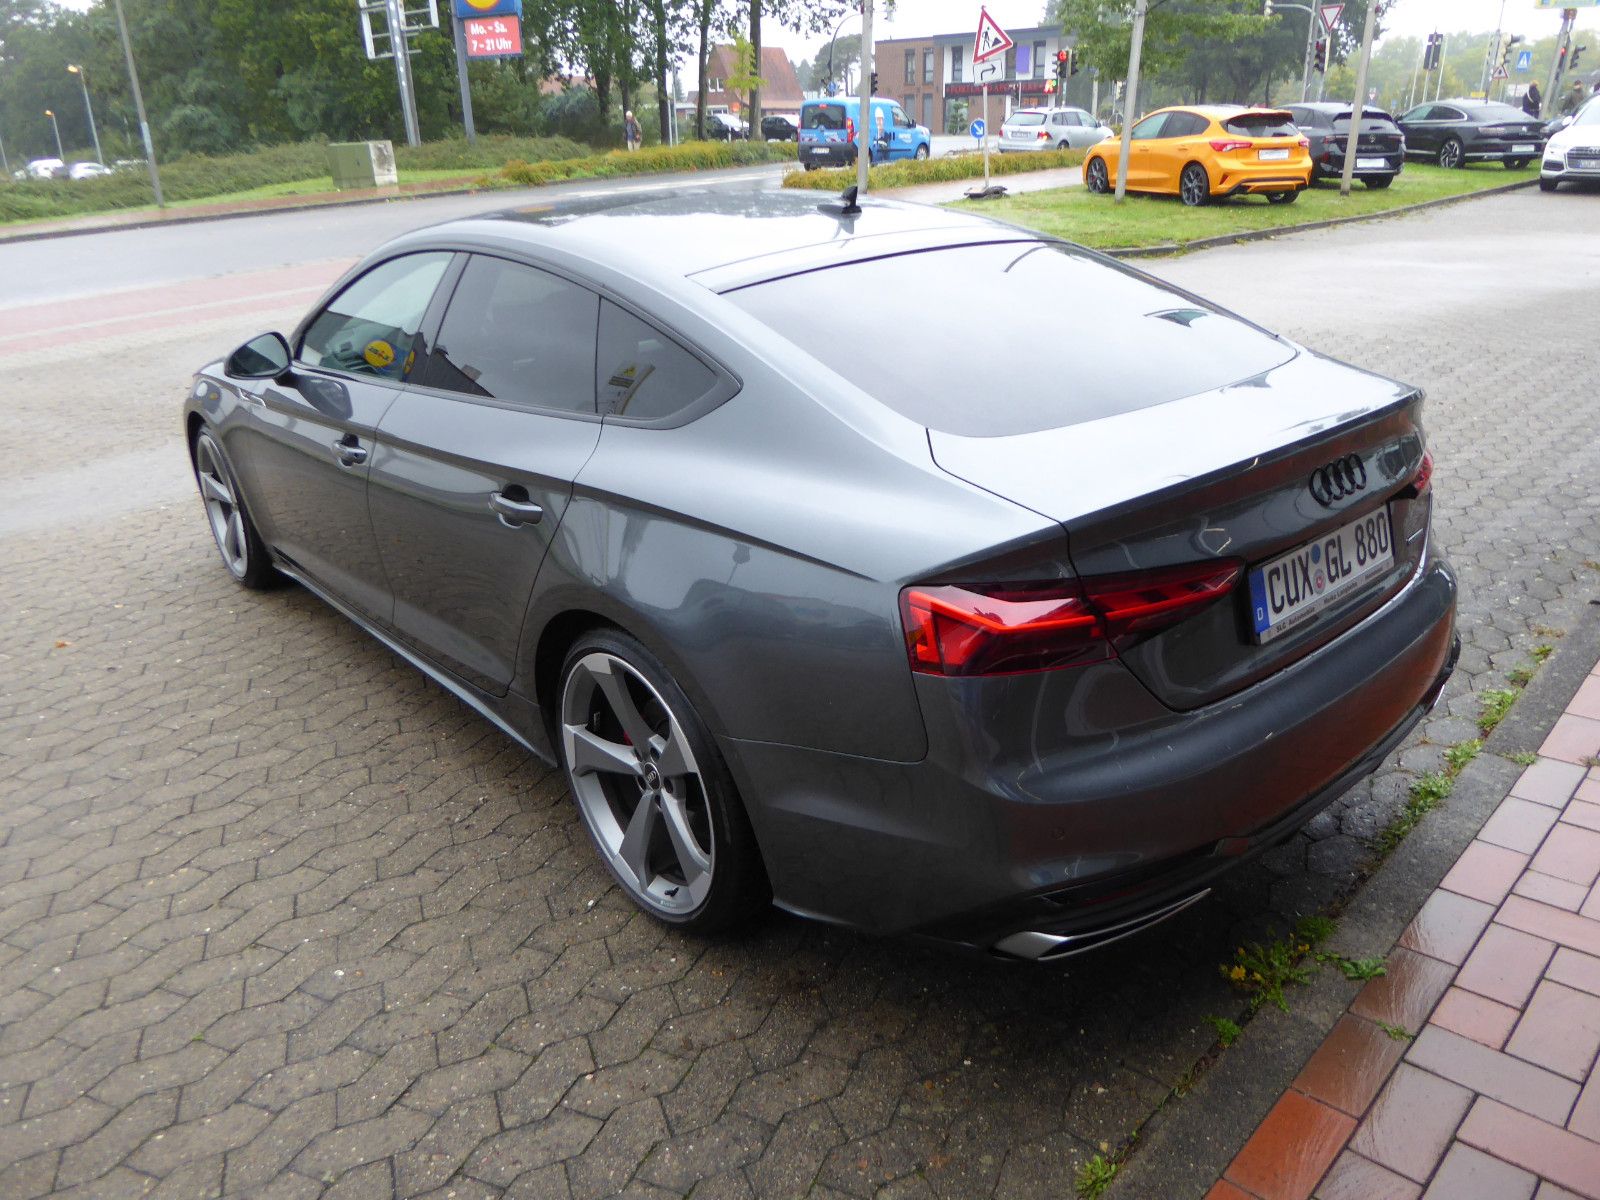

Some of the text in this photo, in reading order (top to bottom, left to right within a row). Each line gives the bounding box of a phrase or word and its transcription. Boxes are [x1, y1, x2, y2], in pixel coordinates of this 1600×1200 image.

[470, 23, 487, 35] Mo.
[494, 21, 507, 33] Sa.
[472, 40, 478, 52] 7
[486, 39, 495, 51] 21
[496, 37, 512, 50] Uhr
[1268, 511, 1389, 614] CUX GL 880
[1257, 606, 1264, 621] D
